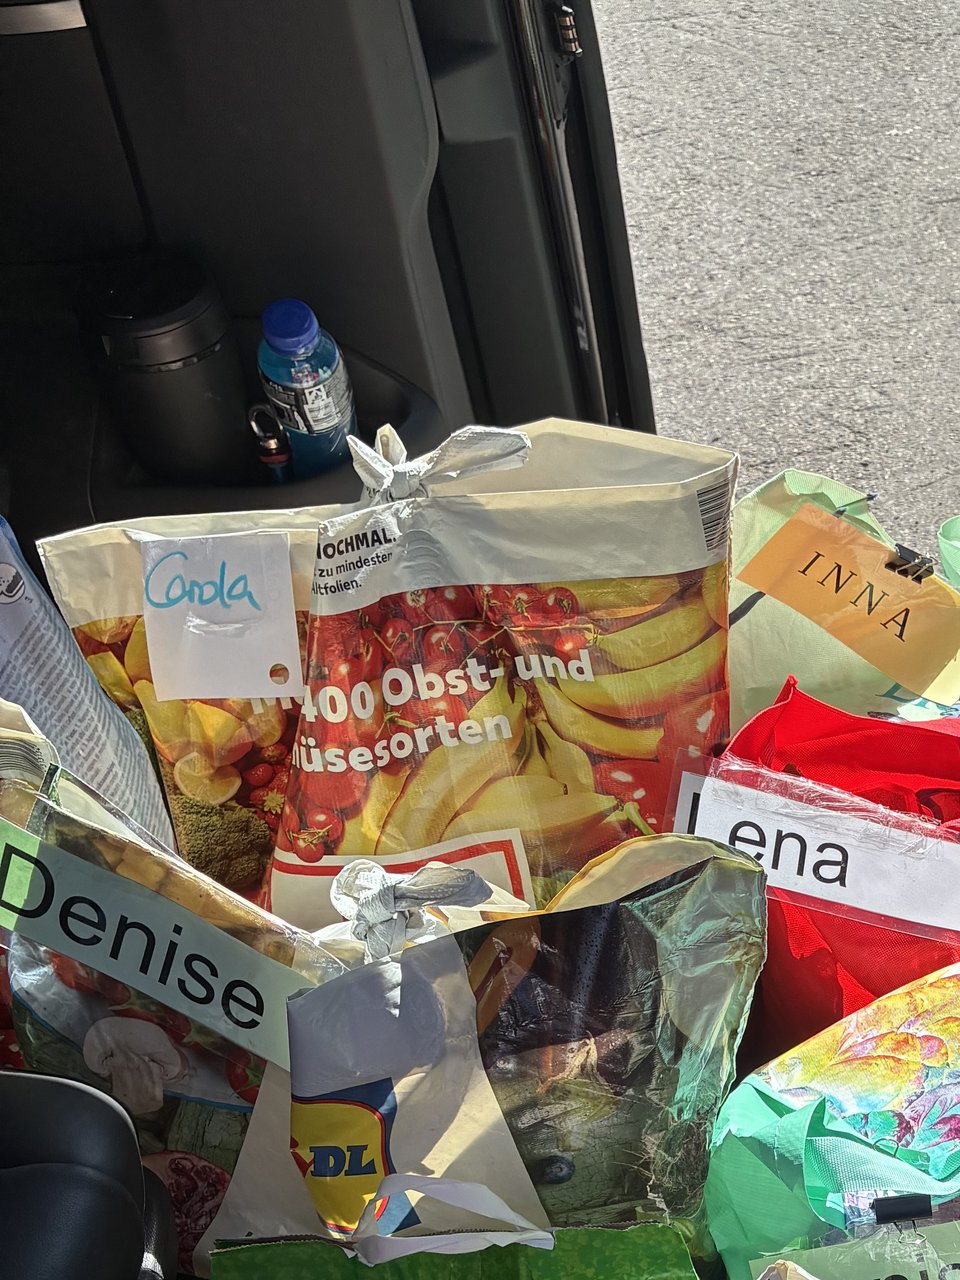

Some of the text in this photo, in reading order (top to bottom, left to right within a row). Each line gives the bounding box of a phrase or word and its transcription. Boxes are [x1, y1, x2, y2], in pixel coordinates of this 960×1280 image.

[144, 551, 263, 611] Carola
[318, 567, 334, 578] zu
[797, 550, 916, 642] INNA
[300, 681, 375, 725] 400
[382, 656, 505, 706] Obst-
[515, 649, 596, 682] und
[0, 842, 265, 1031] Denise
